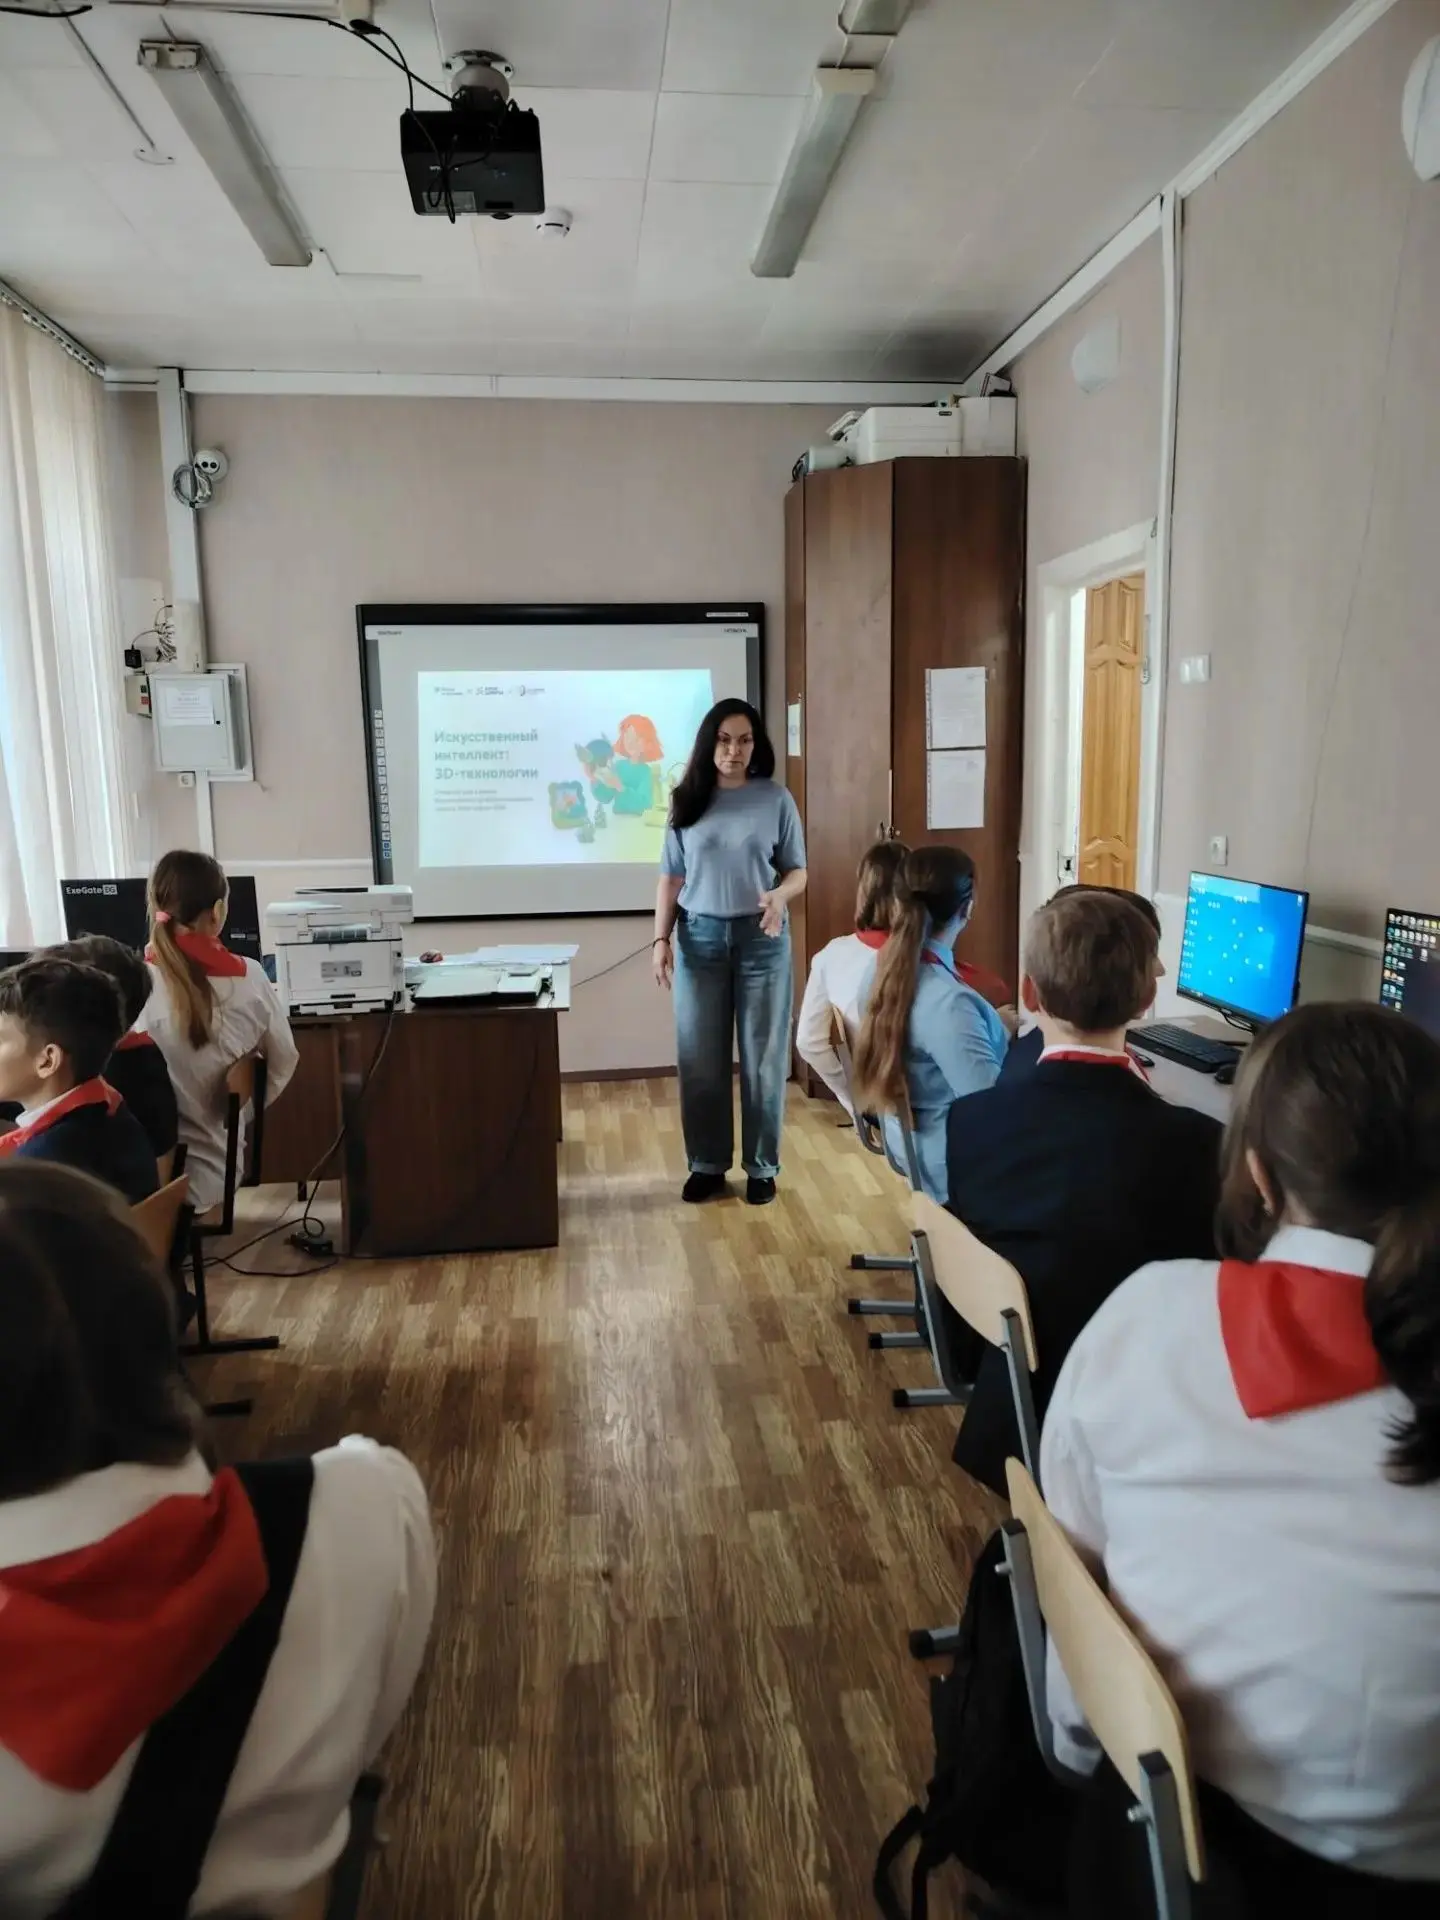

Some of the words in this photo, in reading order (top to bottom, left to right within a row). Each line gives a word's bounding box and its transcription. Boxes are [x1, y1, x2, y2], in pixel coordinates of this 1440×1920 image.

[434, 728, 539, 745] Искусственный
[434, 767, 539, 780] 3D-технологии
[65, 887, 102, 895] ExeGate
